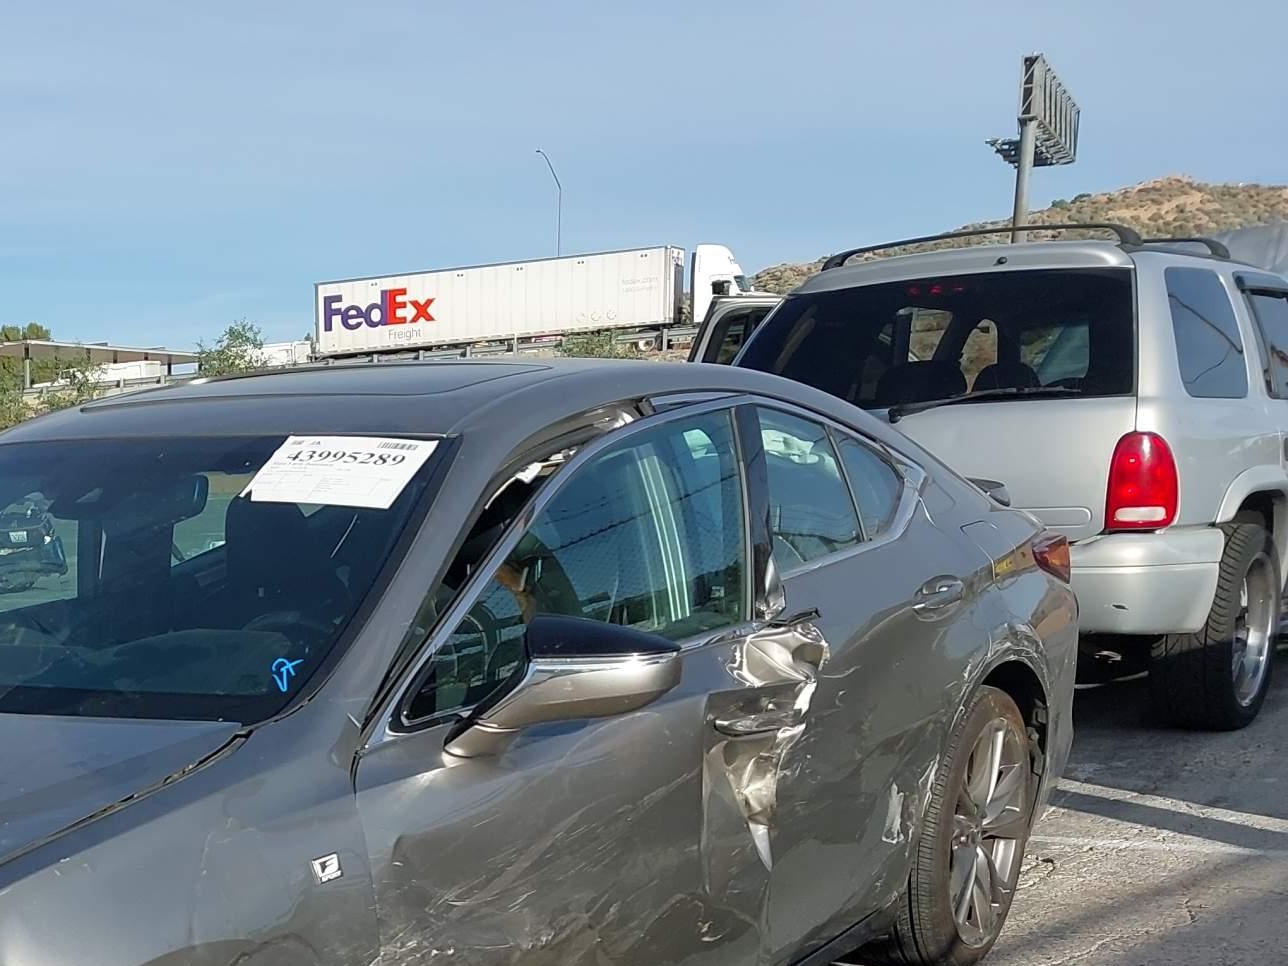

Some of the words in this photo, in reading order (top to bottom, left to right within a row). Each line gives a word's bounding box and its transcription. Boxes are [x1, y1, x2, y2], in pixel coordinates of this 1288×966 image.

[323, 287, 436, 332] FedEx
[388, 328, 422, 341] Freight
[287, 450, 406, 466] 43995289
